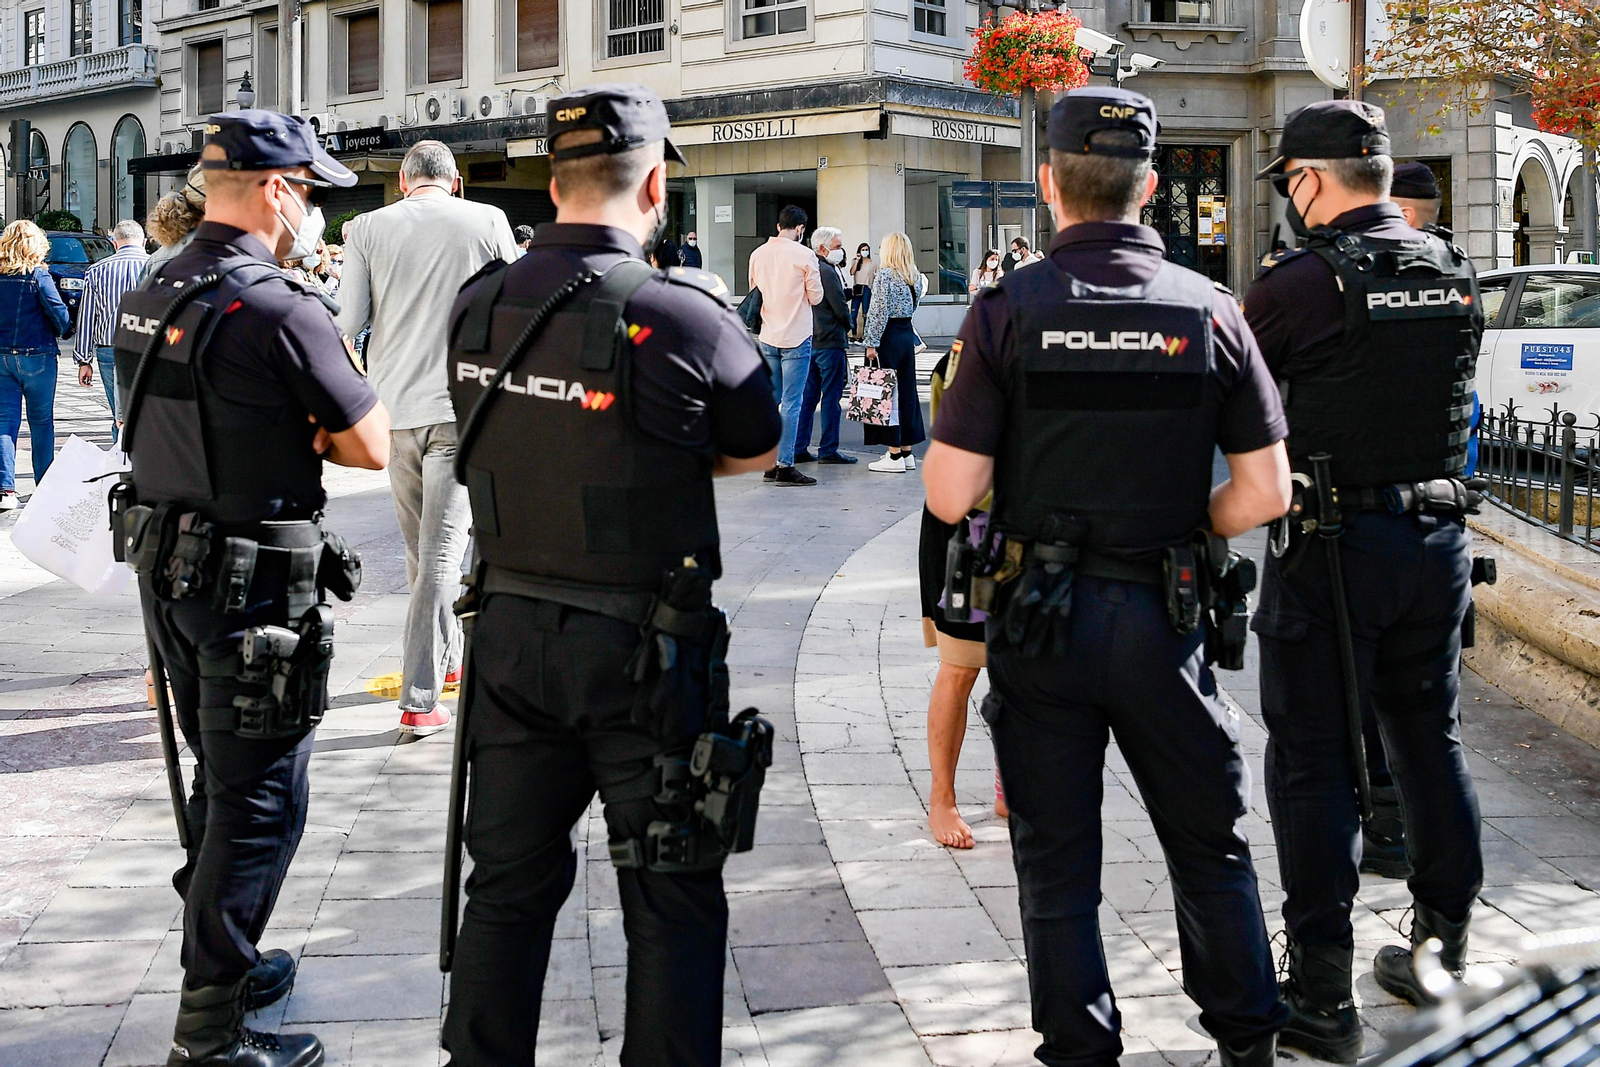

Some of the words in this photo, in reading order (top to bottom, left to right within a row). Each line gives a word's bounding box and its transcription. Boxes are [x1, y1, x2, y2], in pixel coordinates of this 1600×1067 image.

[555, 106, 587, 122] CNP
[1099, 105, 1136, 119] CNP
[712, 118, 797, 142] ROSSELLI
[932, 119, 997, 143] ROSSELLI
[345, 134, 381, 151] joyeros
[1366, 287, 1464, 310] POLICIA
[120, 312, 171, 339] POLIC
[1041, 330, 1167, 350] POLICIA
[456, 361, 588, 403] POLICIA
